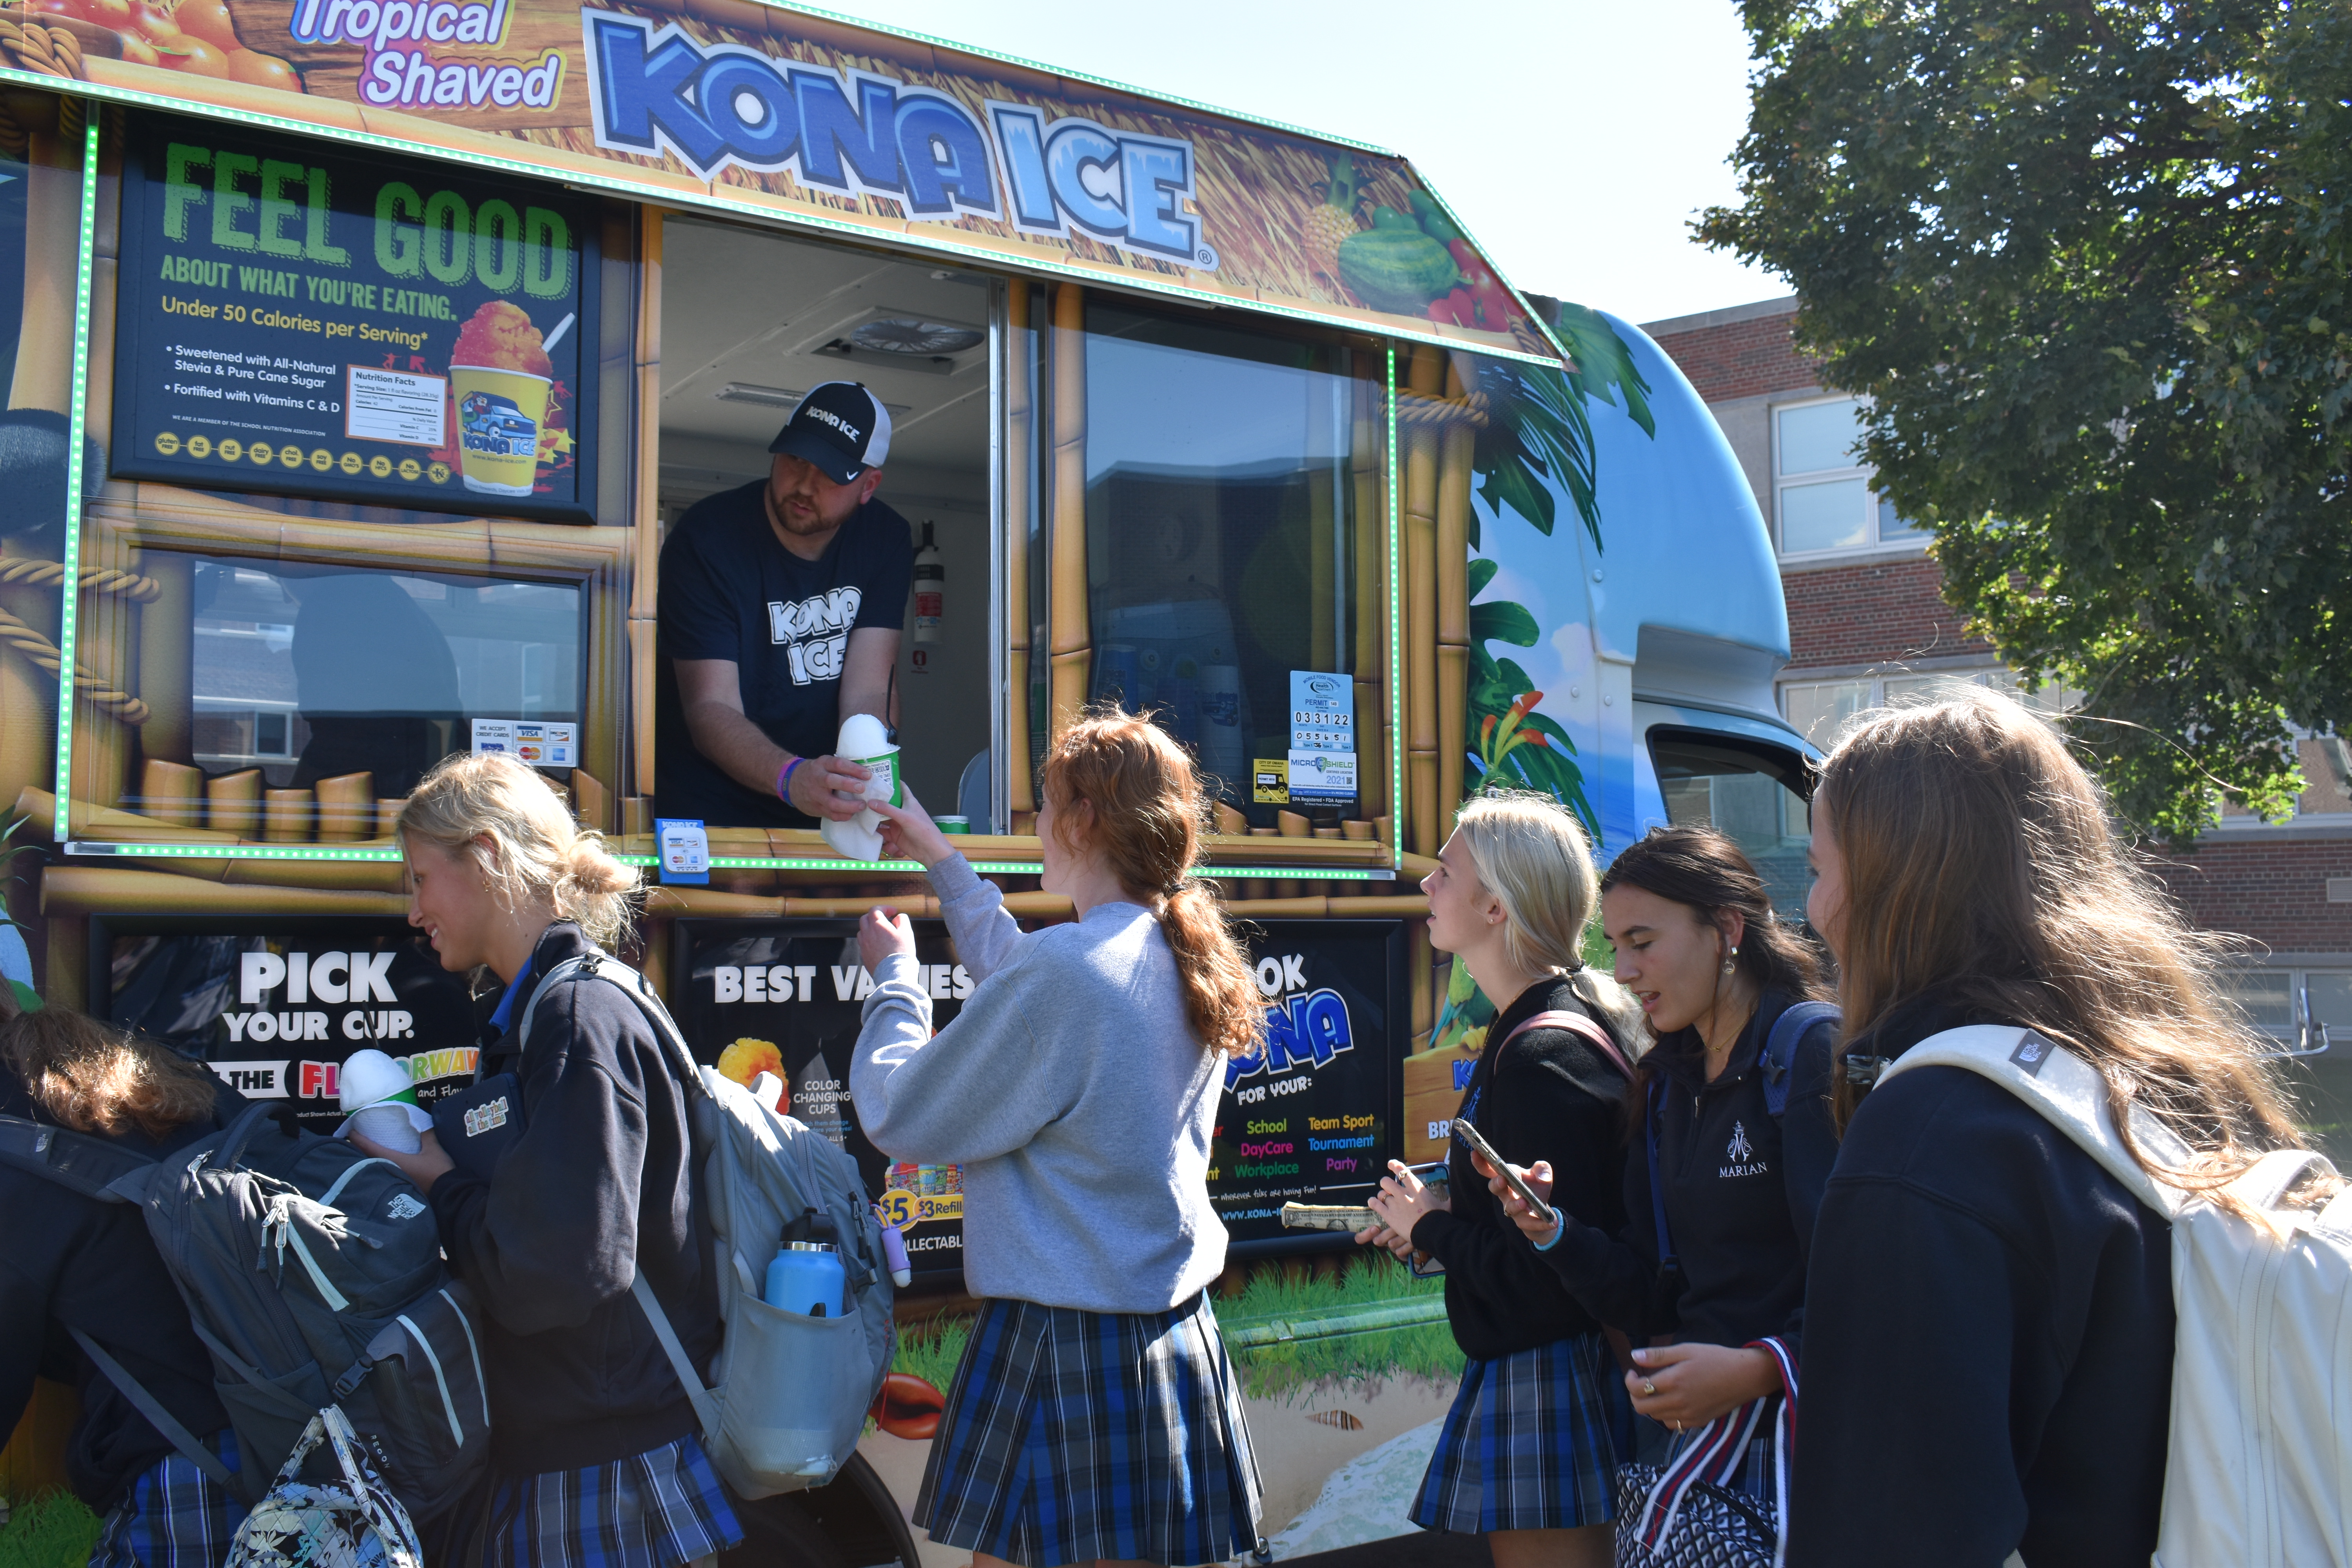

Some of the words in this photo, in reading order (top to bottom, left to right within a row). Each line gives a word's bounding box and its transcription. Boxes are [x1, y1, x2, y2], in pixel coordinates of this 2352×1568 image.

[299, 0, 507, 51] Tropical
[365, 51, 559, 106] Shaved
[588, 14, 1000, 216] KONA
[991, 104, 1196, 262] ICE
[163, 142, 352, 269] FEEL
[374, 181, 572, 301] GOOD
[161, 254, 232, 289] ABOUT
[239, 265, 299, 298] WHAT
[306, 274, 376, 310] YOU'RE
[383, 287, 458, 321] EATING.
[162, 296, 218, 319] Under
[223, 304, 246, 323] 50
[252, 308, 321, 332] Calories
[326, 321, 354, 338] per
[175, 345, 242, 363] Sweetened
[246, 355, 270, 367] with
[274, 357, 336, 375] All-Natural
[175, 359, 211, 374] Stevia
[214, 365, 225, 375] &
[228, 367, 255, 379] Pure
[258, 370, 289, 383] Cane
[291, 374, 326, 389] Sugar
[356, 372, 393, 383] Nutrition
[395, 377, 416, 386] Facts
[174, 383, 222, 399] Fortified
[225, 391, 250, 402] with
[253, 393, 304, 409] Vitamins
[307, 399, 315, 410] C
[318, 401, 328, 411] &
[331, 402, 340, 412] D
[293, 428, 326, 437] ASSOCIATION
[806, 406, 840, 427] KONA
[838, 420, 860, 443] ICE
[158, 437, 178, 446] gluten
[253, 447, 269, 456] dairy
[463, 431, 510, 455] KONA
[512, 438, 537, 456] ICE
[472, 454, 527, 464] www.kona-ice.com
[768, 586, 862, 644] KONA
[787, 632, 847, 686] ICE
[1303, 675, 1316, 684] MOBILE
[1327, 677, 1341, 688] VENDOR
[1296, 712, 1310, 723] 03
[1315, 713, 1328, 724] 31
[1334, 715, 1348, 725] 22
[1327, 775, 1345, 784] 2021
[240, 951, 398, 1004] PICK
[715, 965, 816, 1003] BEST
[831, 964, 975, 1001] VAES
[222, 1012, 329, 1042] YOUR
[342, 1011, 414, 1040] CUP.
[229, 1070, 274, 1089] THE
[804, 1080, 840, 1091] COLOR
[1237, 1086, 1266, 1105] FOR
[1269, 1075, 1312, 1097] YOUR:
[417, 1085, 436, 1097] and
[793, 1091, 851, 1103] CHANGING
[808, 1103, 837, 1114] CUPS
[1247, 1118, 1287, 1134] School
[1308, 1117, 1340, 1131] Team
[1343, 1114, 1375, 1131] Sport
[1241, 1141, 1293, 1159] DayCare
[1308, 1134, 1375, 1151] Tournament
[1235, 1161, 1299, 1179] Workplace
[1326, 1157, 1357, 1173] Party
[1719, 1162, 1768, 1178] MARIAN
[387, 1195, 404, 1209] THE
[1253, 1189, 1267, 1198] folks
[1283, 1187, 1301, 1198] having
[1303, 1185, 1317, 1194] Fun!
[387, 1203, 410, 1219] NORTH
[882, 1197, 909, 1225] $5
[935, 1201, 963, 1214] Refill
[903, 1234, 962, 1252] LLECTABL
